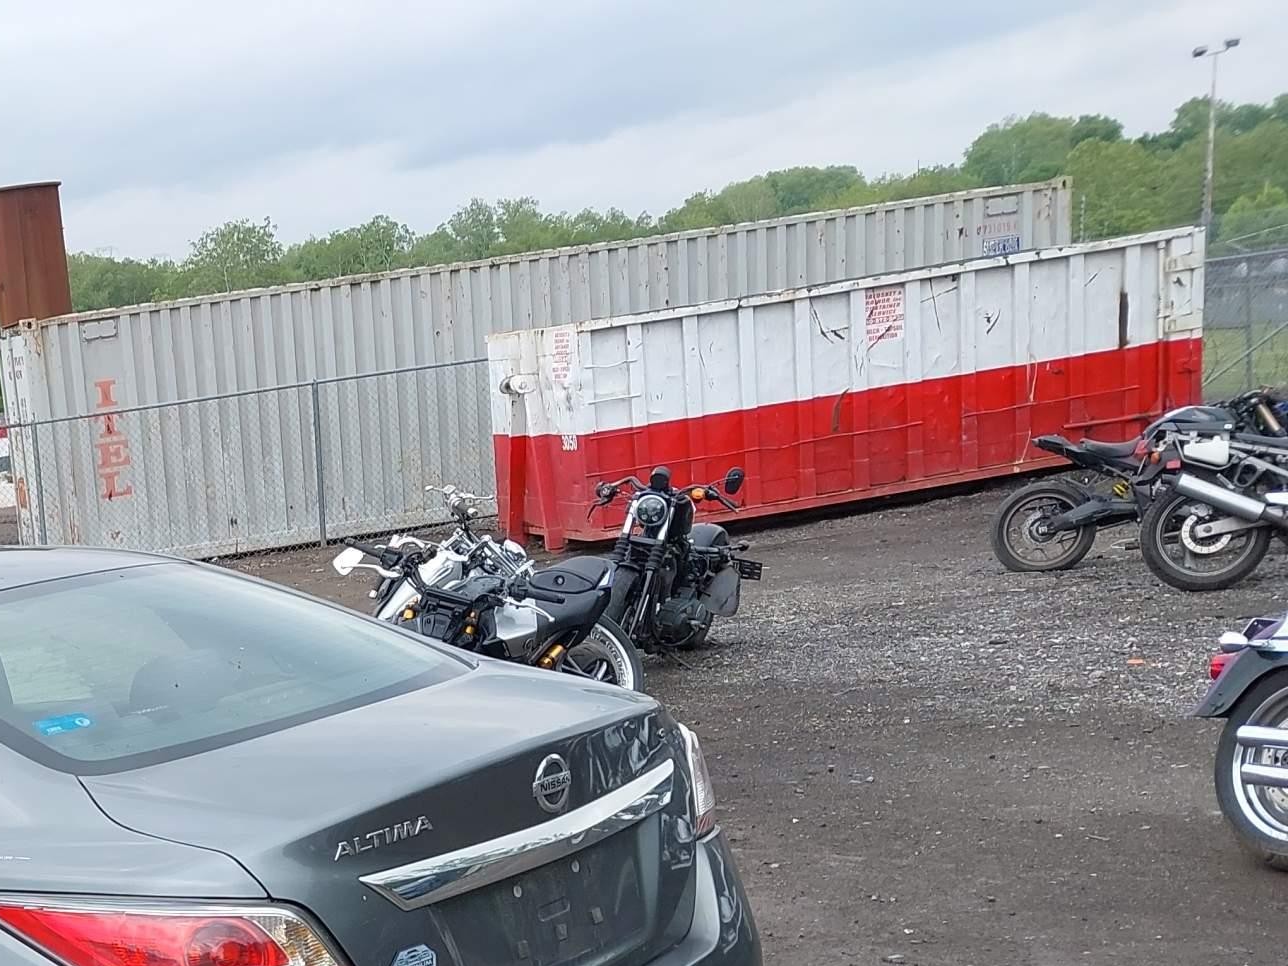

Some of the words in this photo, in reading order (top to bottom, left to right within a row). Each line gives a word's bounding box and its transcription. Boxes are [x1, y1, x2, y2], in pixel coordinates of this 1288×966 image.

[95, 379, 133, 501] ITEL
[561, 434, 578, 451] 3050
[540, 775, 571, 793] NISSAN
[334, 815, 433, 861] ALTIMA
